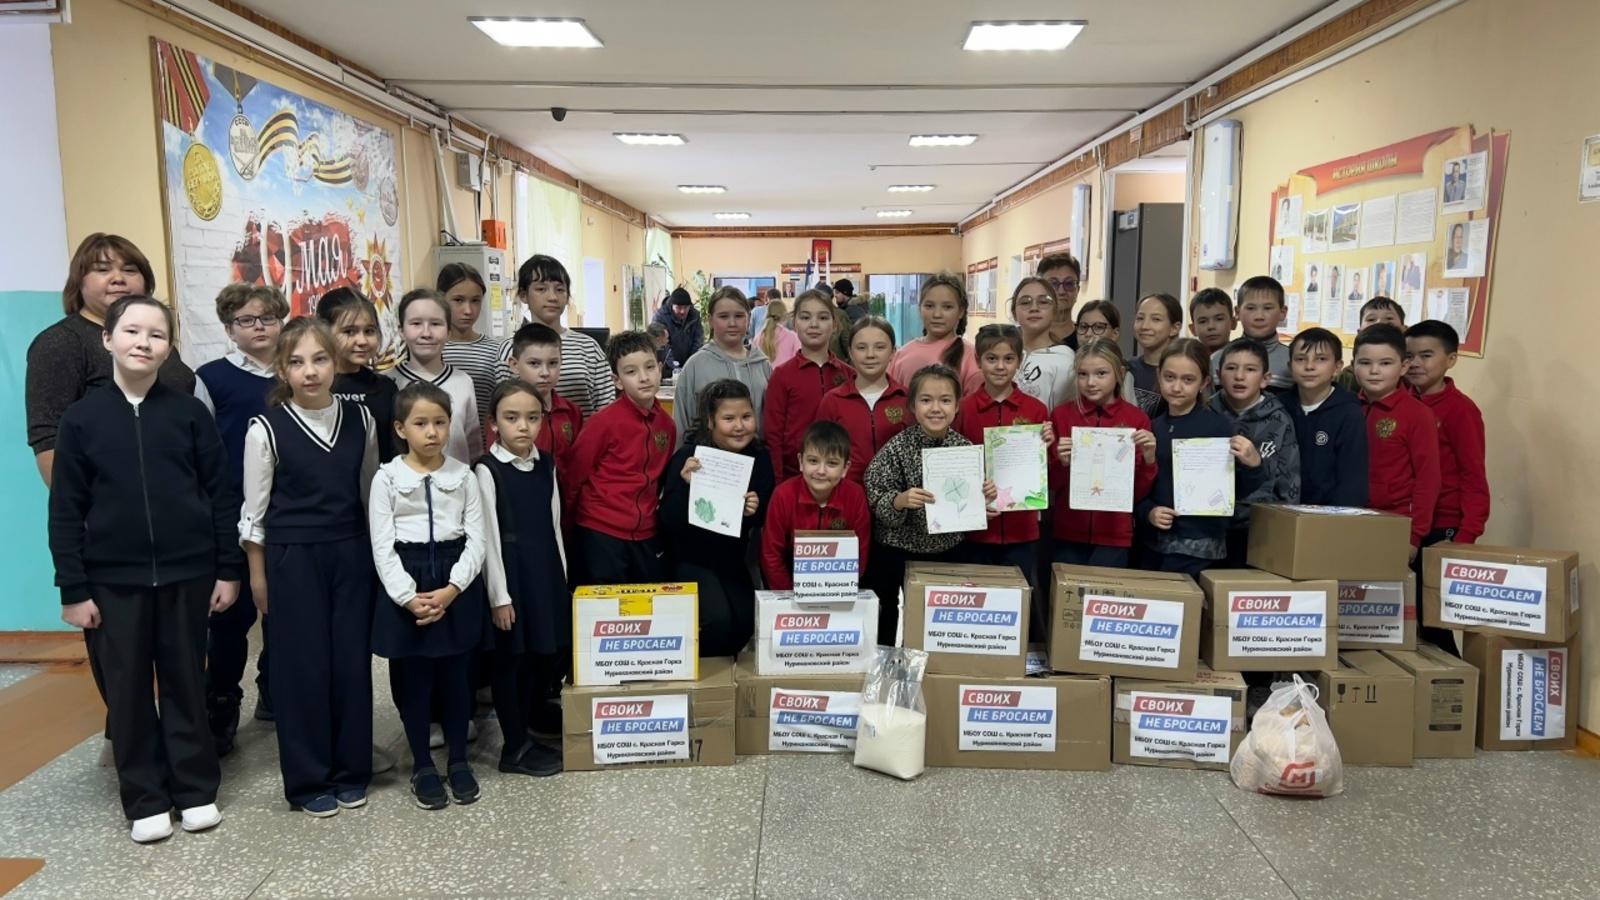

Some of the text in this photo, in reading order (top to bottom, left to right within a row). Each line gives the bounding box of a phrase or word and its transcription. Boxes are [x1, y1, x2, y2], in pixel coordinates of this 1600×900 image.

[1332, 152, 1398, 181] ИСТОРИЯ ШКОЛЫ
[795, 545, 829, 555] ВОИХ
[794, 563, 808, 571] НЕ
[1451, 567, 1496, 581] СВОИХ
[1456, 585, 1535, 601] НЕ БРОСАЕМ
[934, 594, 976, 605] СВОИХ
[1238, 599, 1280, 609] СВОИХ
[1092, 604, 1136, 617] СВОИХ
[1339, 605, 1393, 614] БРОСАЕМ
[781, 617, 820, 627] СВОИХ
[939, 611, 1011, 623] НЕ БРОСАЕМ
[1243, 616, 1316, 625] НЕ БРОСАЕМ
[600, 622, 641, 634] СВОИХ
[1097, 621, 1171, 636] НЕ БРОСАЕМ
[786, 633, 854, 643] НЕ БРОСАЕМ
[606, 639, 676, 650] НЕ БРОСАЕМ
[1550, 657, 1560, 696] СВОИХ
[968, 693, 1011, 704] СВОИХ
[1533, 663, 1544, 730] НЕ БРОСАЕМ
[779, 696, 820, 709] СВОИХ
[1140, 700, 1184, 712] СВОИХ
[601, 704, 644, 715] СВОИХ
[784, 714, 852, 726] НЕ БРОСАЕМ
[974, 711, 1046, 721] НЕ БРОСАЕМ
[607, 721, 679, 731] НЕ БРОСАЕМ
[1145, 718, 1220, 731] НЕ БРОСАЕМ
